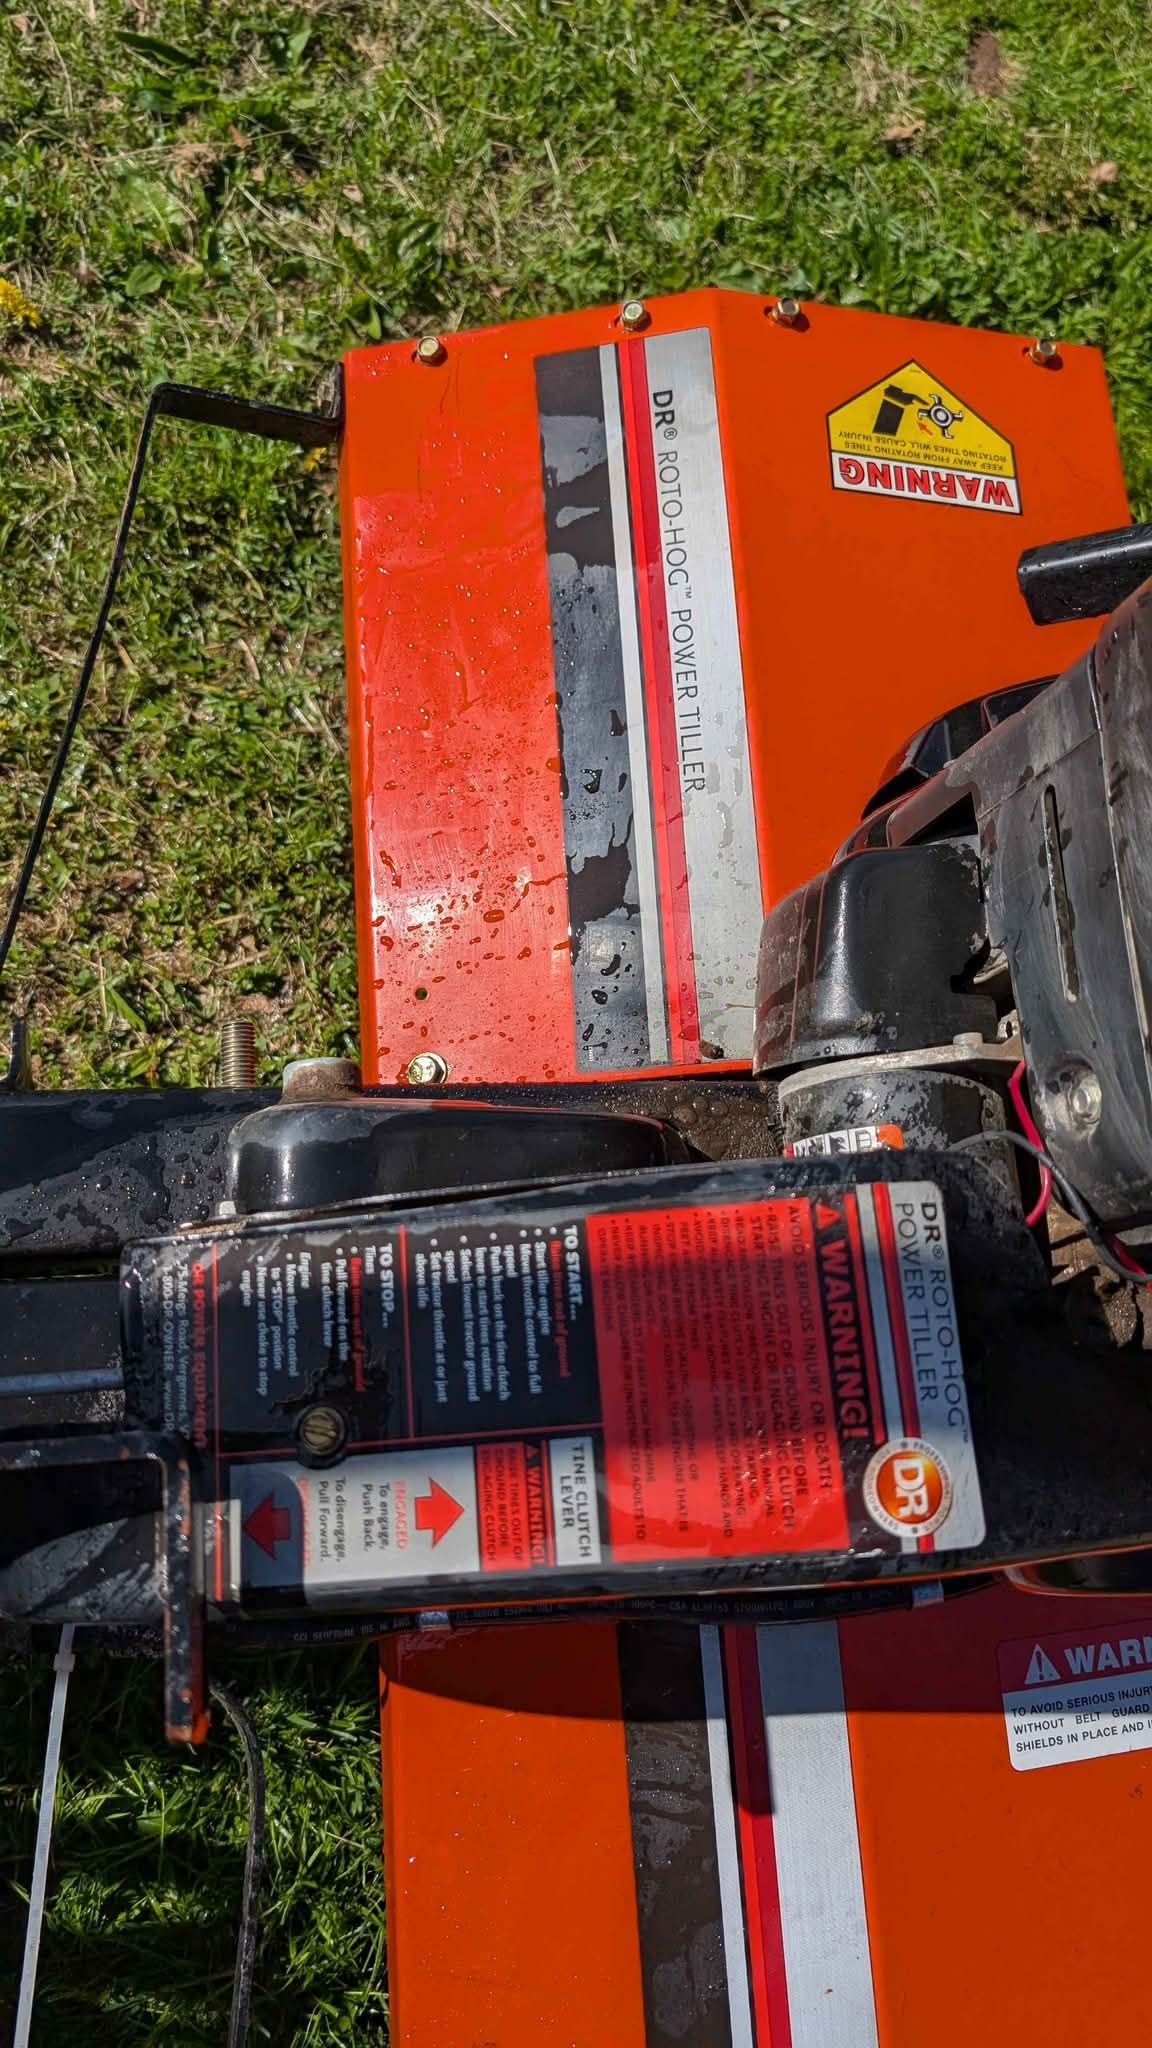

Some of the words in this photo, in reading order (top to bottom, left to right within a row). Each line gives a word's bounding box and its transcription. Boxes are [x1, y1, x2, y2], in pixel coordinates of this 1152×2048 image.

[838, 430, 873, 443] INJURY
[844, 441, 873, 452] TINES
[875, 436, 907, 447] CAUSE
[910, 442, 932, 452] WILL
[933, 445, 960, 456] TINES
[873, 446, 921, 460] ROTATING
[923, 454, 951, 464] FROM
[953, 458, 977, 468] AWAY
[963, 450, 1007, 462] ROTATING
[981, 461, 1003, 471] KEEP
[838, 457, 1014, 507] WARNING
[671, 608, 698, 701] POWER
[679, 706, 706, 793] TILLER
[564, 1225, 579, 1250] TO
[766, 1214, 781, 1252] RAISE
[788, 1205, 805, 1256] AVOID
[364, 1244, 377, 1274] Tines
[379, 1243, 393, 1267] TO
[430, 1251, 443, 1270] Set
[475, 1247, 488, 1274] lever
[490, 1245, 503, 1274] Push
[503, 1244, 519, 1278] speed
[520, 1243, 534, 1273] Move
[534, 1241, 548, 1268] Start
[896, 1201, 926, 1296] POWER
[192, 1262, 205, 1285] DR
[271, 1267, 283, 1280] to
[286, 1263, 298, 1294] Move
[297, 1251, 312, 1289] Engine
[321, 1262, 332, 1284] tine
[335, 1258, 348, 1281] Pull
[415, 1252, 428, 1285] above
[443, 1249, 457, 1283] speed
[459, 1248, 473, 1281] Select
[771, 1258, 786, 1299] TINES
[240, 1269, 253, 1307] engine
[255, 1265, 268, 1299] Never
[431, 1270, 445, 1307] tractor
[477, 1275, 489, 1288] to
[492, 1275, 504, 1301] back
[522, 1274, 537, 1316] throttle
[536, 1269, 550, 1294] tiller
[795, 1261, 814, 1331] SERIOUS
[256, 1300, 268, 1320] use
[322, 1284, 334, 1319] clutch
[336, 1281, 349, 1324] forward
[417, 1286, 430, 1308] idle
[461, 1282, 476, 1319] lowest
[478, 1289, 490, 1315] start
[494, 1303, 505, 1318] on
[193, 1288, 206, 1346] POWER
[287, 1295, 299, 1336] throttle
[433, 1308, 447, 1351] throttle
[479, 1316, 492, 1345] tines
[495, 1319, 507, 1338] the
[538, 1296, 553, 1335] engine
[776, 1303, 790, 1334] OUT
[257, 1321, 269, 1354] choke
[272, 1324, 285, 1369] position
[323, 1320, 335, 1347] lever
[338, 1325, 350, 1340] on
[463, 1319, 478, 1358] tractor
[525, 1317, 539, 1358] control
[821, 1240, 870, 1438] WARNING!
[257, 1356, 269, 1369] to
[288, 1337, 300, 1376] control
[338, 1341, 351, 1360] the
[435, 1352, 448, 1364] at
[496, 1340, 508, 1363] tine
[780, 1339, 793, 1360] OF
[803, 1336, 821, 1393] INJURY
[910, 1313, 940, 1401] TILLER
[436, 1365, 448, 1378] or
[466, 1359, 480, 1402] ground
[481, 1345, 495, 1391] rotation
[528, 1359, 540, 1372] to
[258, 1370, 270, 1395] stop
[437, 1379, 450, 1402] just
[497, 1364, 511, 1400] clutch
[529, 1373, 542, 1393] full
[783, 1363, 801, 1433] GROUND
[811, 1400, 825, 1425] OR
[572, 1443, 587, 1484] TINE
[791, 1438, 809, 1496] BEFORE
[814, 1431, 833, 1488] DEATH
[319, 1480, 330, 1503] Pull
[332, 1477, 347, 1491] To
[362, 1483, 374, 1514] Push
[377, 1482, 391, 1497] To
[510, 1482, 520, 1515] TINES
[891, 1457, 932, 1517] DR
[394, 1480, 409, 1549] ENGAGED
[526, 1466, 547, 1564] WARNING!
[560, 1475, 575, 1528] LEVER
[485, 1514, 497, 1561] CLUTCH
[498, 1503, 510, 1547] BEFORE
[512, 1518, 522, 1542] OUT
[576, 1490, 592, 1557] CLUTCH
[514, 1545, 523, 1560] OF
[1011, 1707, 1026, 1717] TO
[1030, 1701, 1064, 1714] AVOID
[1067, 1692, 1115, 1709] SERIOUS
[1013, 1718, 1065, 1735] WITHOUT
[1075, 1711, 1102, 1725] BELT
[1016, 1736, 1064, 1752] SHIELDS
[1067, 1733, 1079, 1743] IN
[1082, 1726, 1118, 1740] PLACE
[1122, 1721, 1144, 1734] AND
